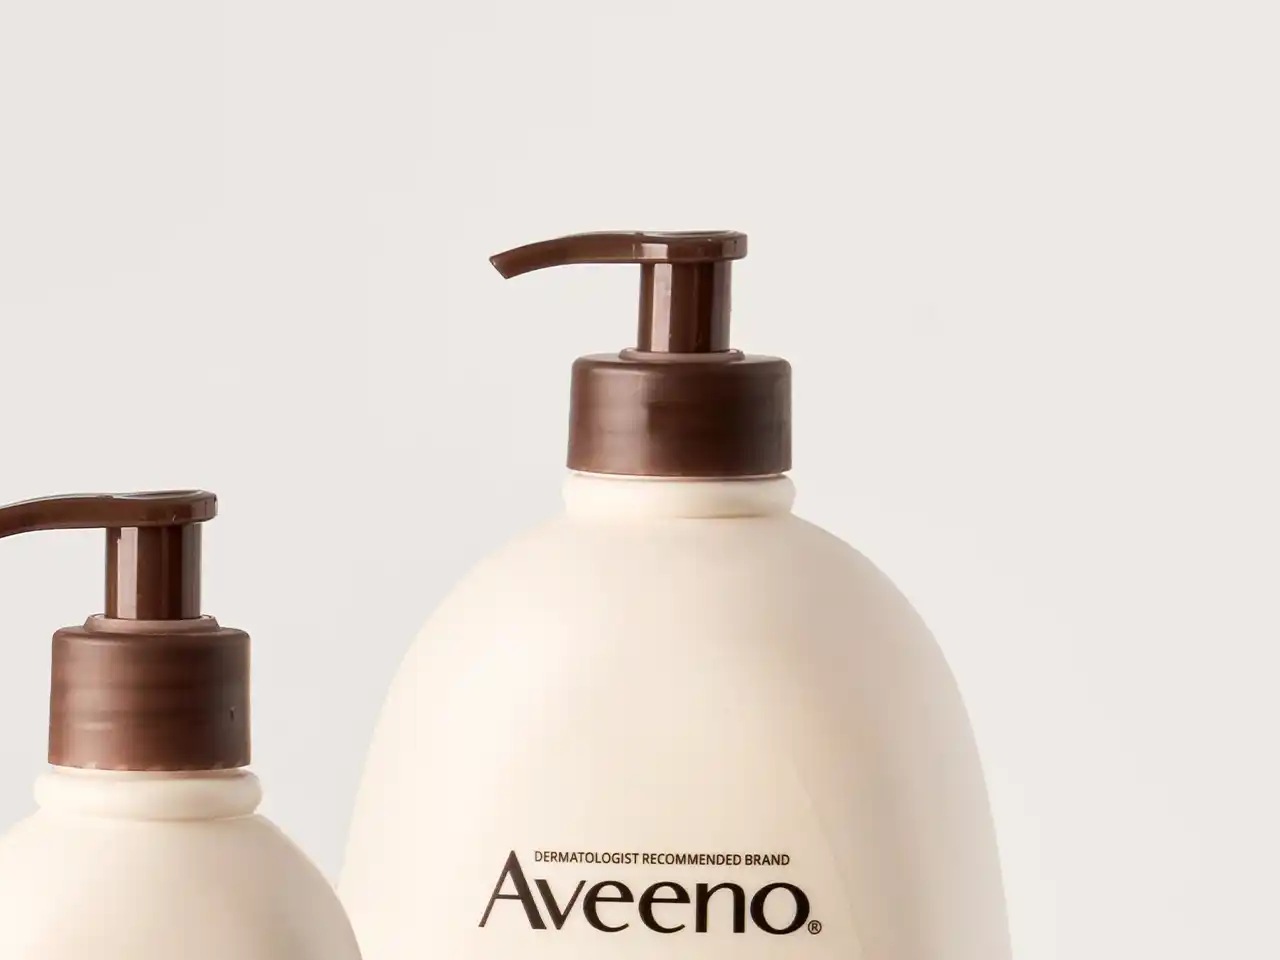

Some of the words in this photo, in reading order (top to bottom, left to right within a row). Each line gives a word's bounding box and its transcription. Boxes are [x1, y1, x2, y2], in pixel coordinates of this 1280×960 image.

[534, 850, 639, 865] DERMATOLOGIST
[642, 853, 742, 866] RECOMMENDED
[745, 854, 790, 866] BRAND
